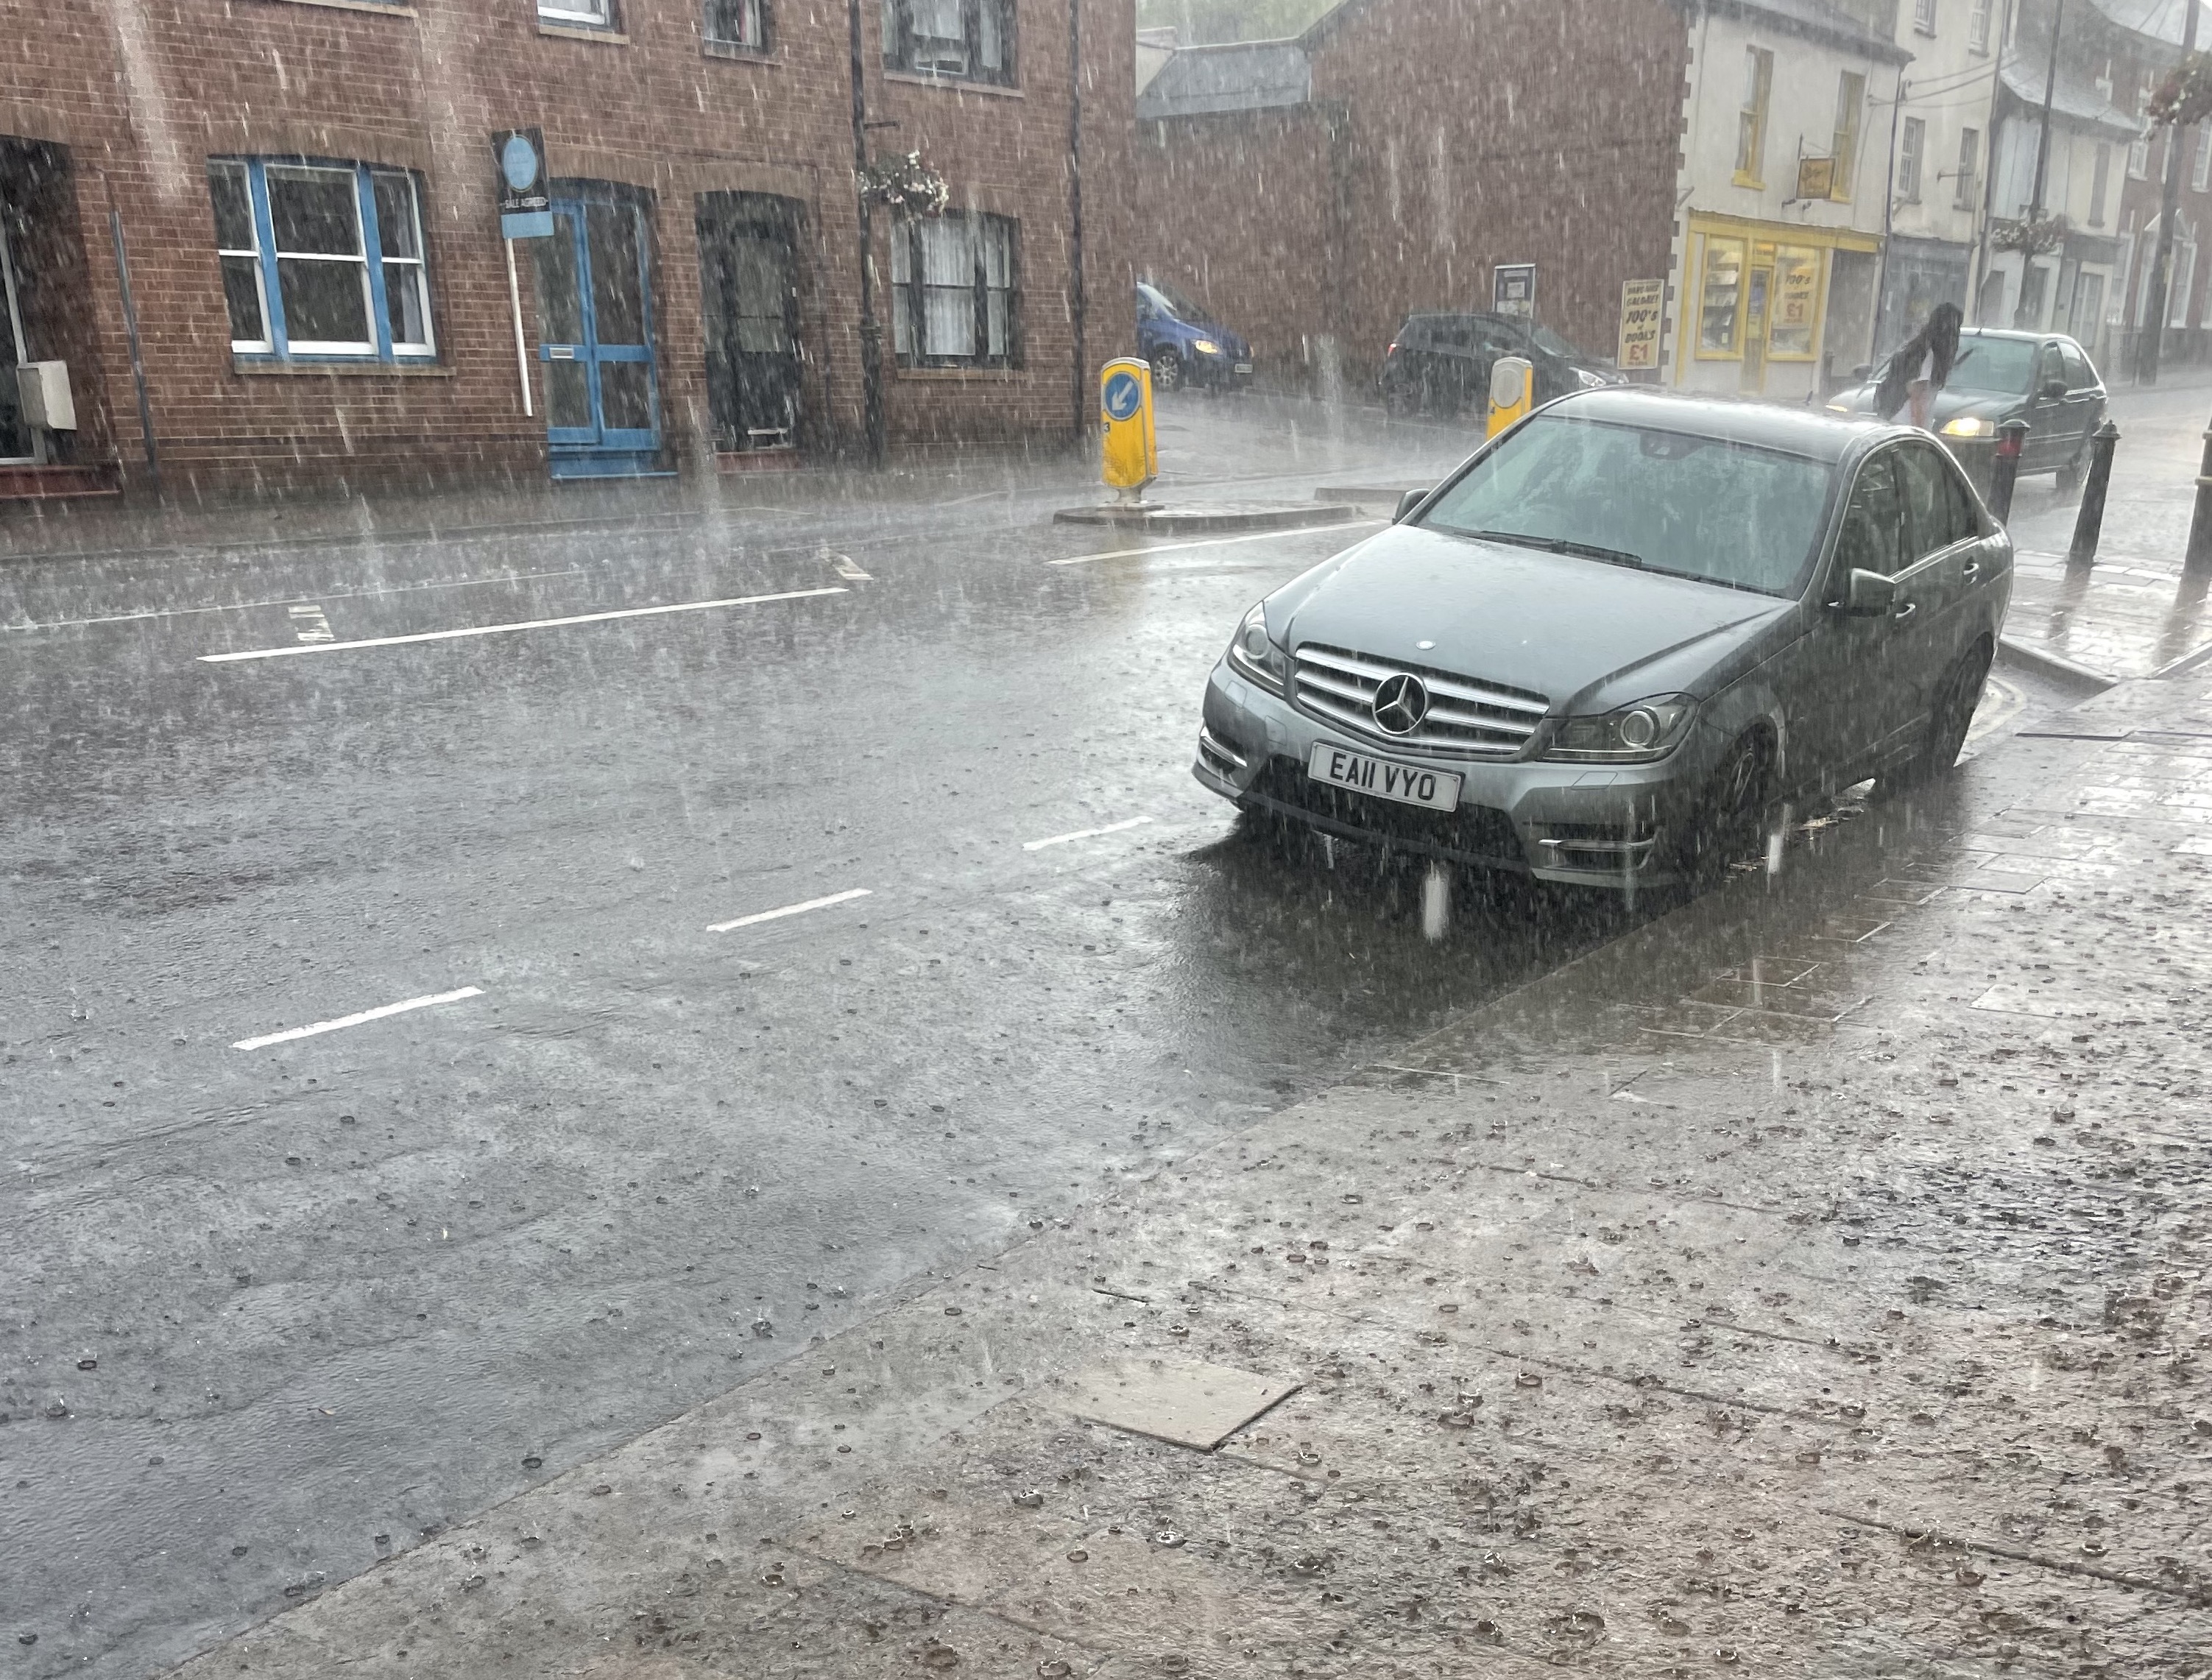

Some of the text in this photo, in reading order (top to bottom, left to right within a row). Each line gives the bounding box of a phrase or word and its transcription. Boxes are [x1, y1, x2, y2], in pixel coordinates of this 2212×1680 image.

[1630, 344, 1648, 361] £1
[1103, 422, 1110, 432] 3
[1329, 751, 1435, 801] EA11 VYO
